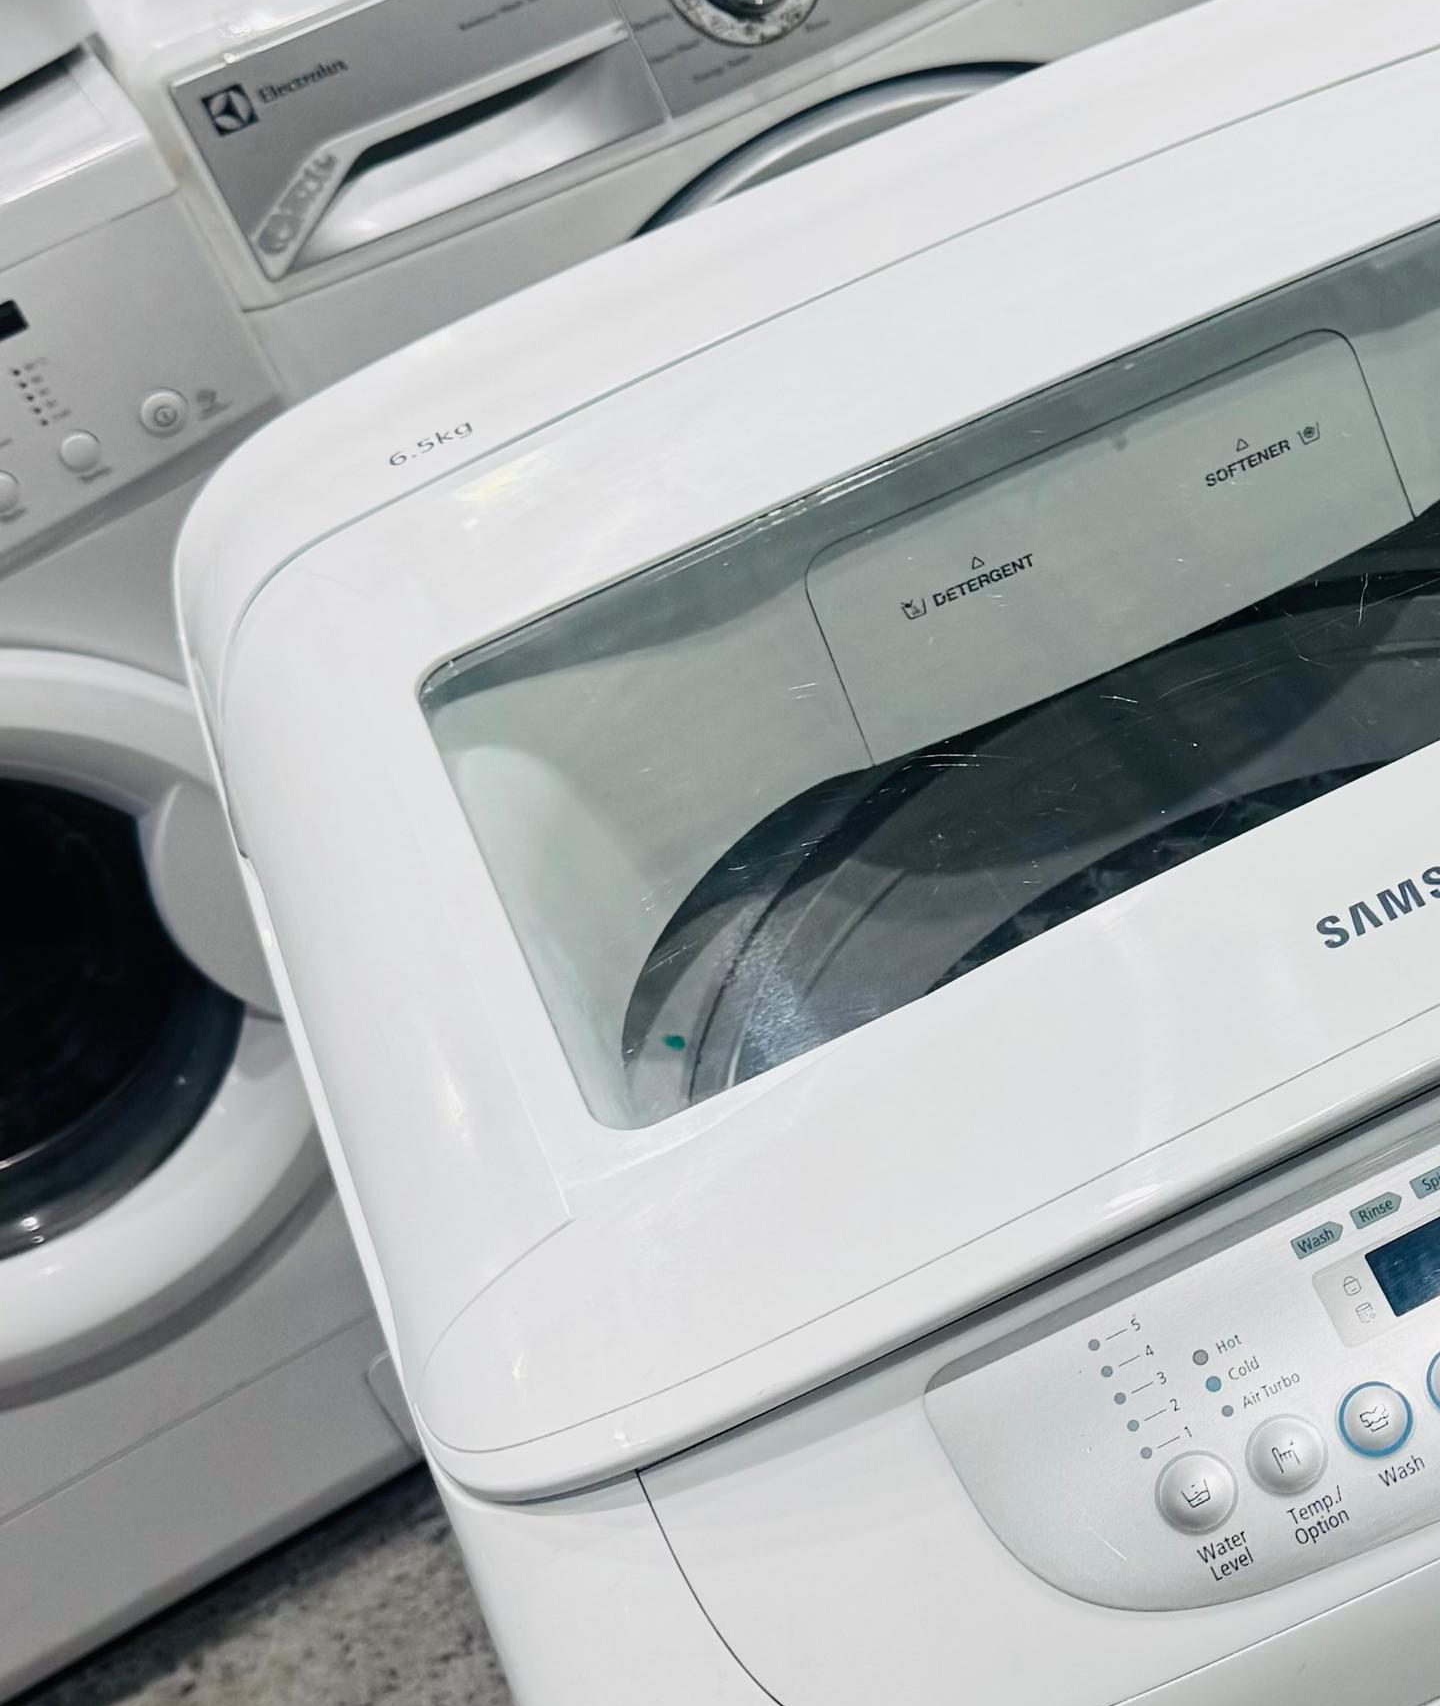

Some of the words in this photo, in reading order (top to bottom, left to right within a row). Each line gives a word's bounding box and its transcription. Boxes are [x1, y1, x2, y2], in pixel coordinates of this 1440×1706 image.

[258, 59, 349, 104] Electrolux
[388, 420, 474, 468] 6.5kg
[1205, 438, 1292, 488] SOFTENER
[932, 553, 1035, 608] DETERGENT
[1358, 1197, 1393, 1224] Rinse
[1297, 1227, 1335, 1255] Wash
[1130, 1317, 1142, 1332] 5
[1144, 1343, 1155, 1358] 4
[1215, 1334, 1242, 1355] Hot
[1156, 1371, 1168, 1386] 3
[1227, 1355, 1260, 1381] Cold
[1169, 1397, 1181, 1413] 2
[1243, 1391, 1261, 1409] Air
[1261, 1371, 1301, 1399] Turbo
[1183, 1425, 1194, 1439] 1
[1378, 1455, 1426, 1489] Wash
[1287, 1484, 1343, 1526] Temp./
[1294, 1508, 1350, 1546] Option
[1196, 1529, 1248, 1565] Water
[1210, 1547, 1254, 1583] Level
